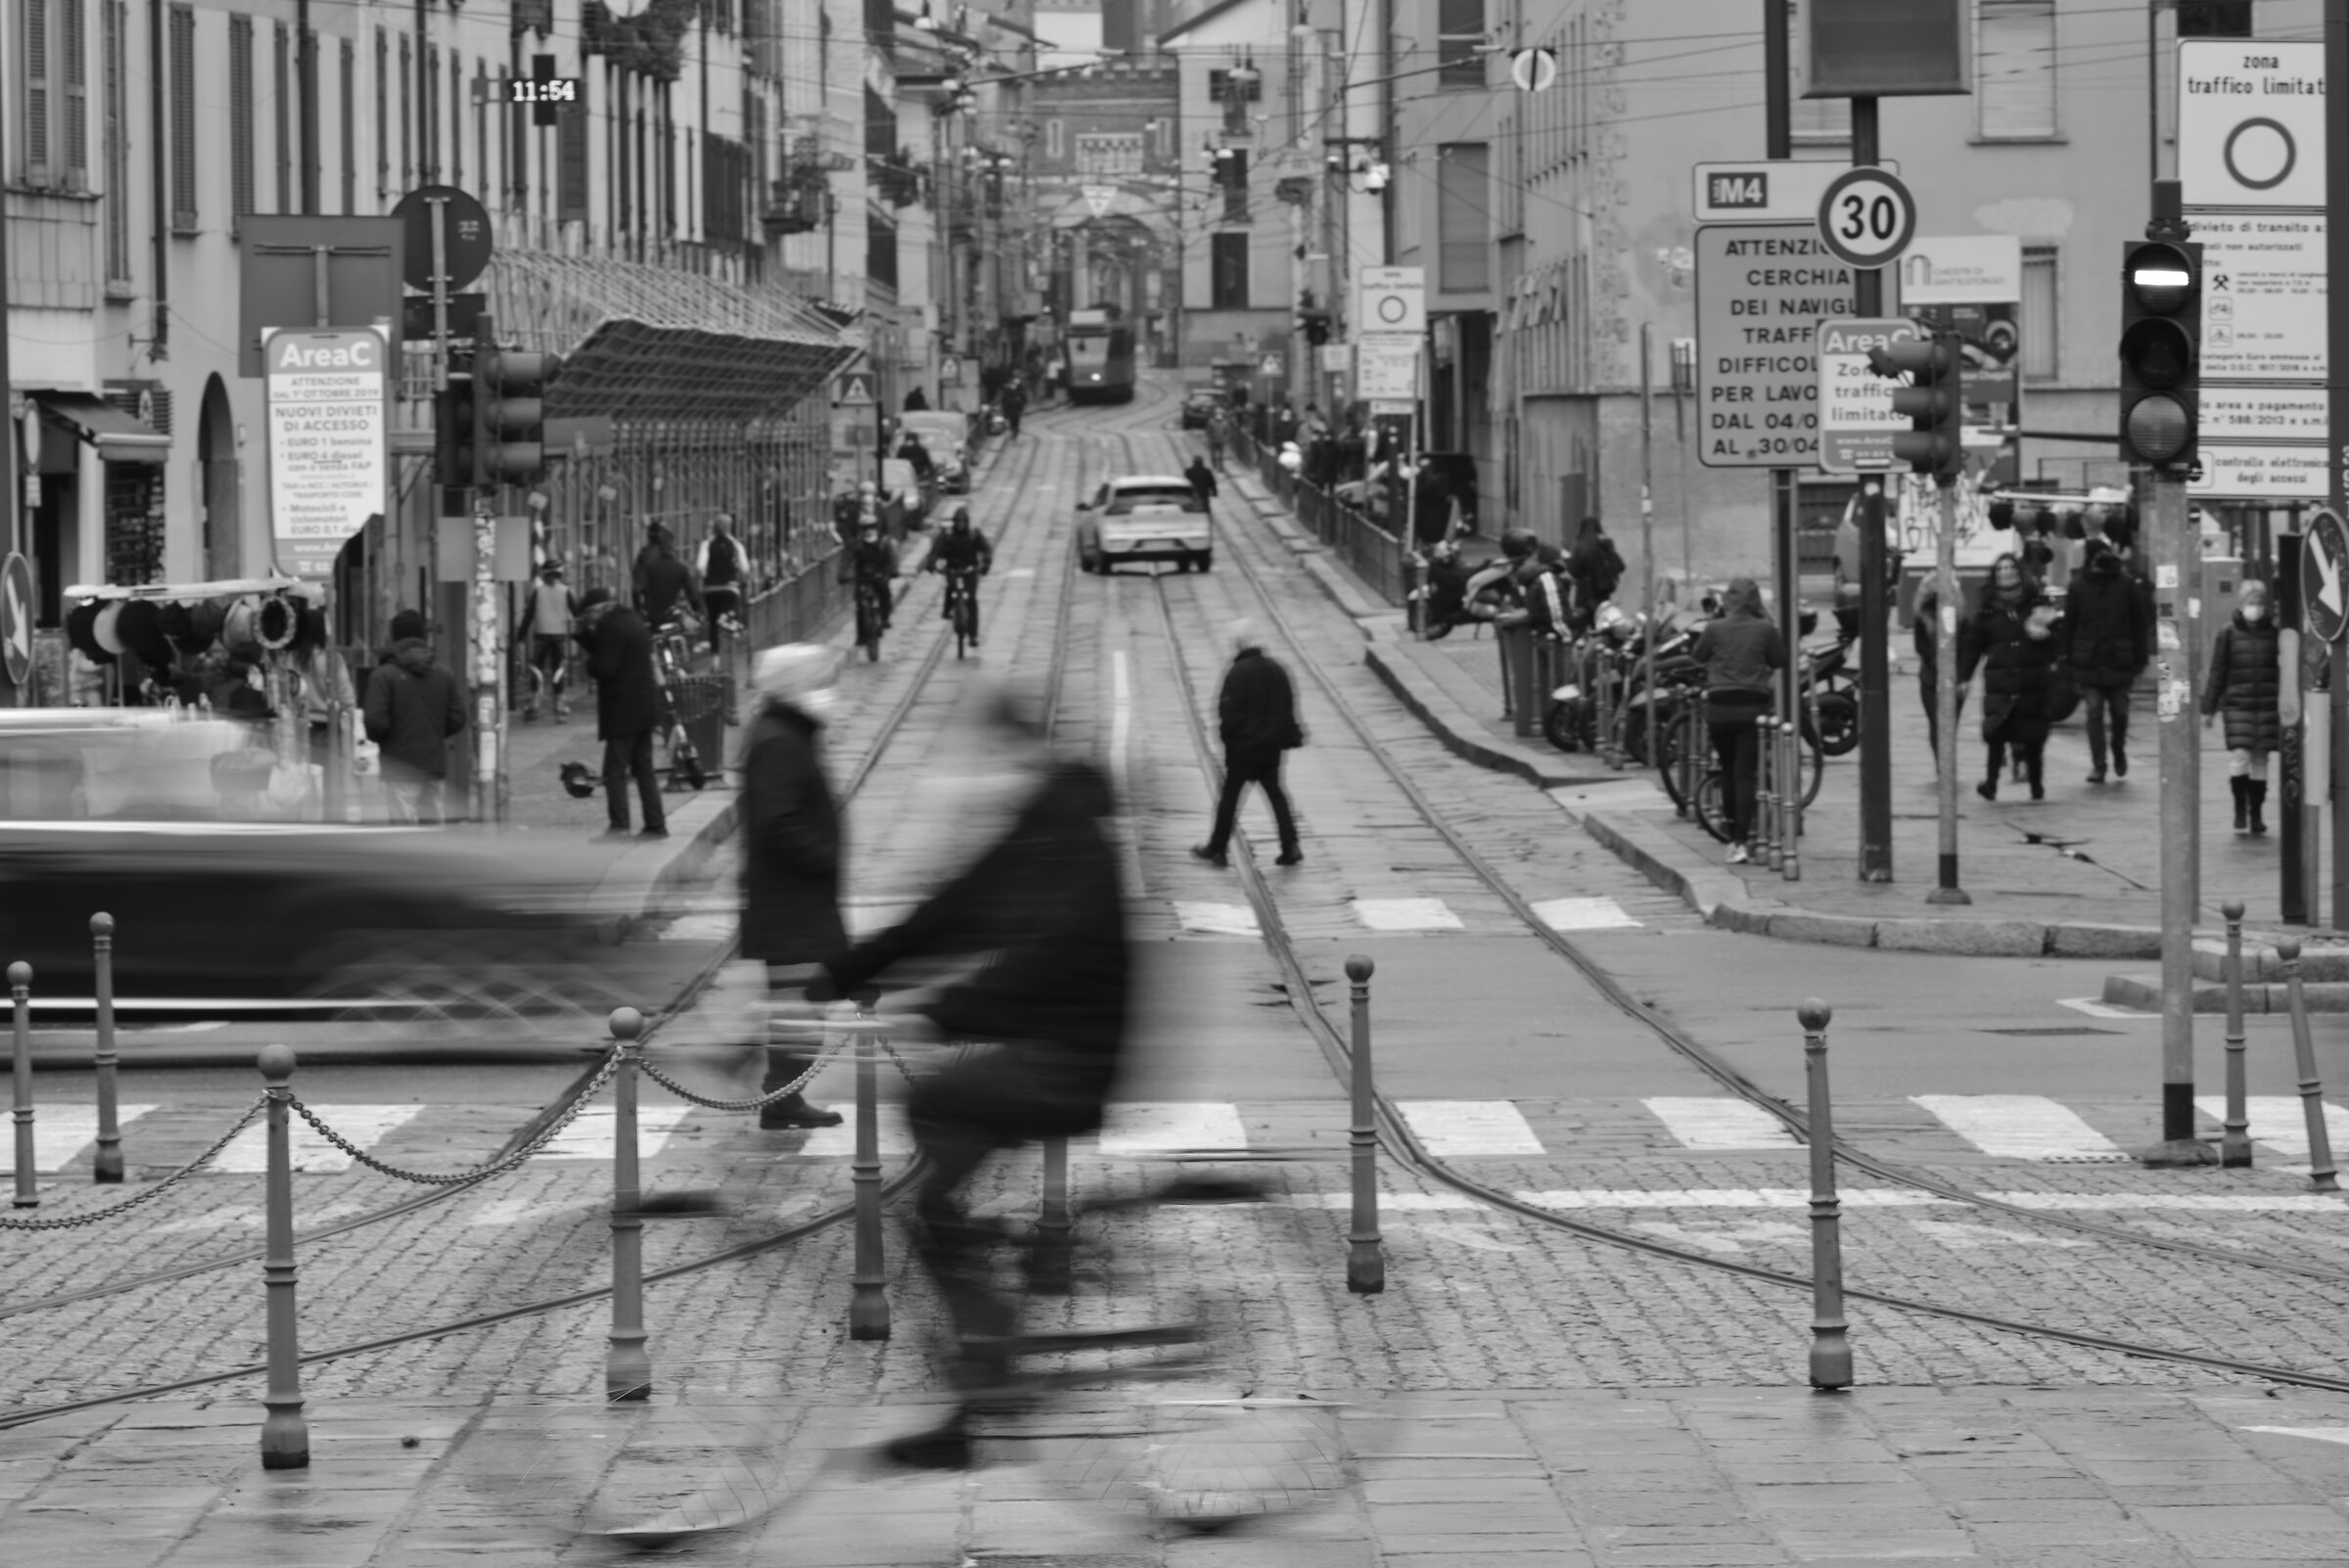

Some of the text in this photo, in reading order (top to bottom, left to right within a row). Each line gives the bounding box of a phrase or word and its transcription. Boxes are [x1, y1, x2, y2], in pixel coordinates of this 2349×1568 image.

[2243, 56, 2280, 69] zona
[513, 80, 576, 102] 11:54
[2188, 76, 2326, 95] traffico limitat
[1720, 177, 1763, 204] M4
[1841, 194, 1896, 241] 30
[2190, 222, 2234, 233] divieto
[2239, 222, 2251, 233] di
[2257, 222, 2309, 233] transito
[1746, 269, 1851, 286] CERCHIA
[1730, 298, 1857, 315] DEI NAVIGL
[1742, 327, 1816, 344] TRAFF
[279, 341, 372, 368] AreaC
[1719, 356, 1818, 374] DIFFICOL
[1837, 363, 1874, 377] Zon
[291, 376, 360, 387] ATTENZIONE
[303, 389, 351, 398] OTTOBRE
[1711, 385, 1818, 402] PER LAVO
[1835, 384, 1893, 397] traffic
[275, 405, 378, 418] NUOVI DIVIETI
[2258, 401, 2326, 412] pagamento
[284, 419, 369, 432] DI ACCESSO
[1711, 413, 1818, 430] DAL 04/0
[287, 438, 318, 447] EURO
[331, 437, 372, 446] benzina
[1713, 438, 1819, 455] AL 30/04
[287, 451, 318, 461] EURO
[2215, 456, 2265, 467] controllo
[2237, 472, 2308, 484] degli accessi
[290, 526, 320, 535] EURO
